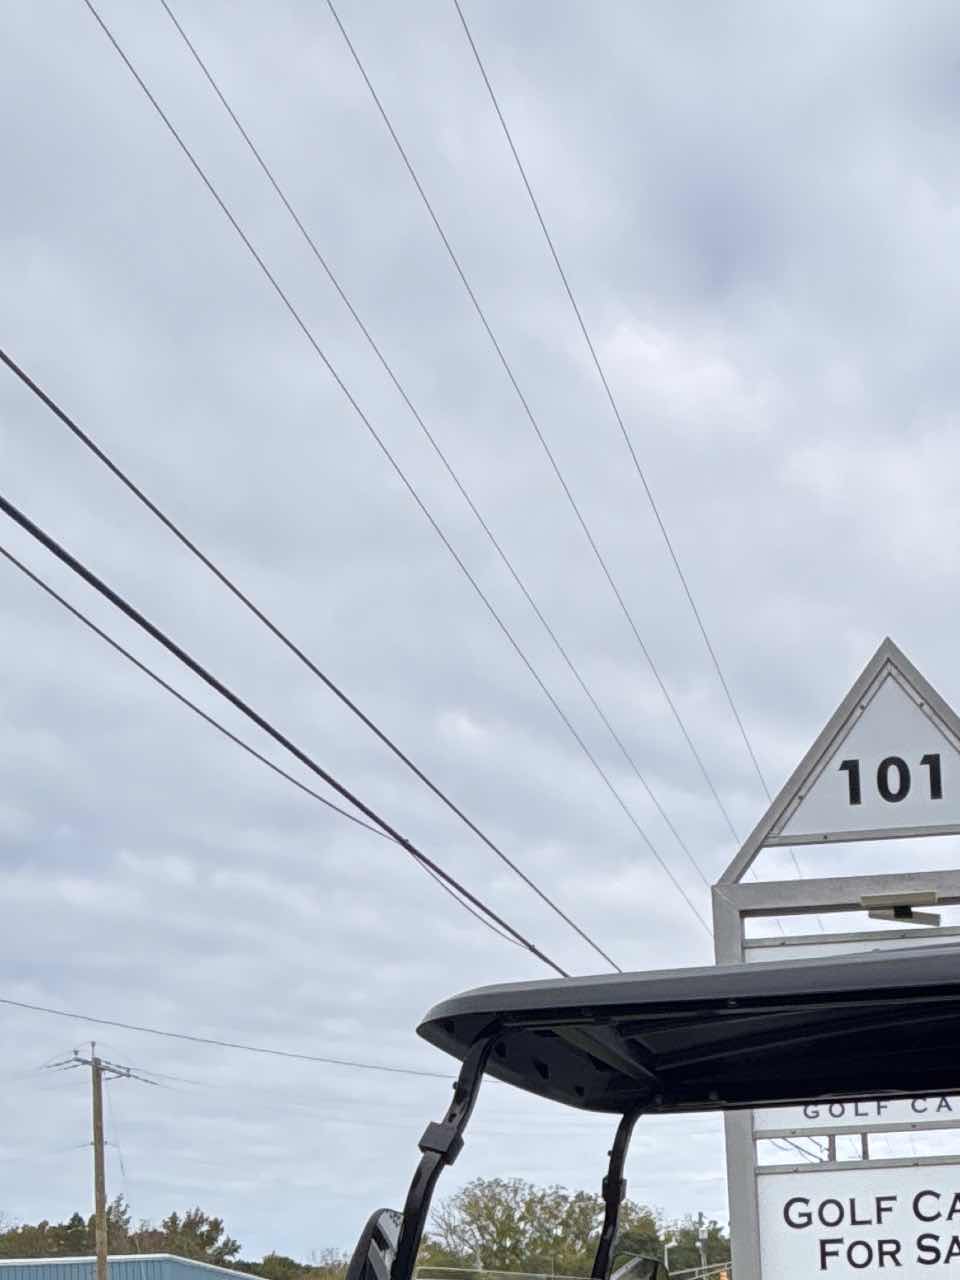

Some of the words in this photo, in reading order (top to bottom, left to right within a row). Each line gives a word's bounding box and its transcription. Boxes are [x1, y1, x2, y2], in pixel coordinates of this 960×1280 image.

[838, 753, 943, 806] 101
[803, 1100, 888, 1119] GOLF
[783, 1195, 897, 1229] GOLF
[818, 1237, 902, 1271] FOR
